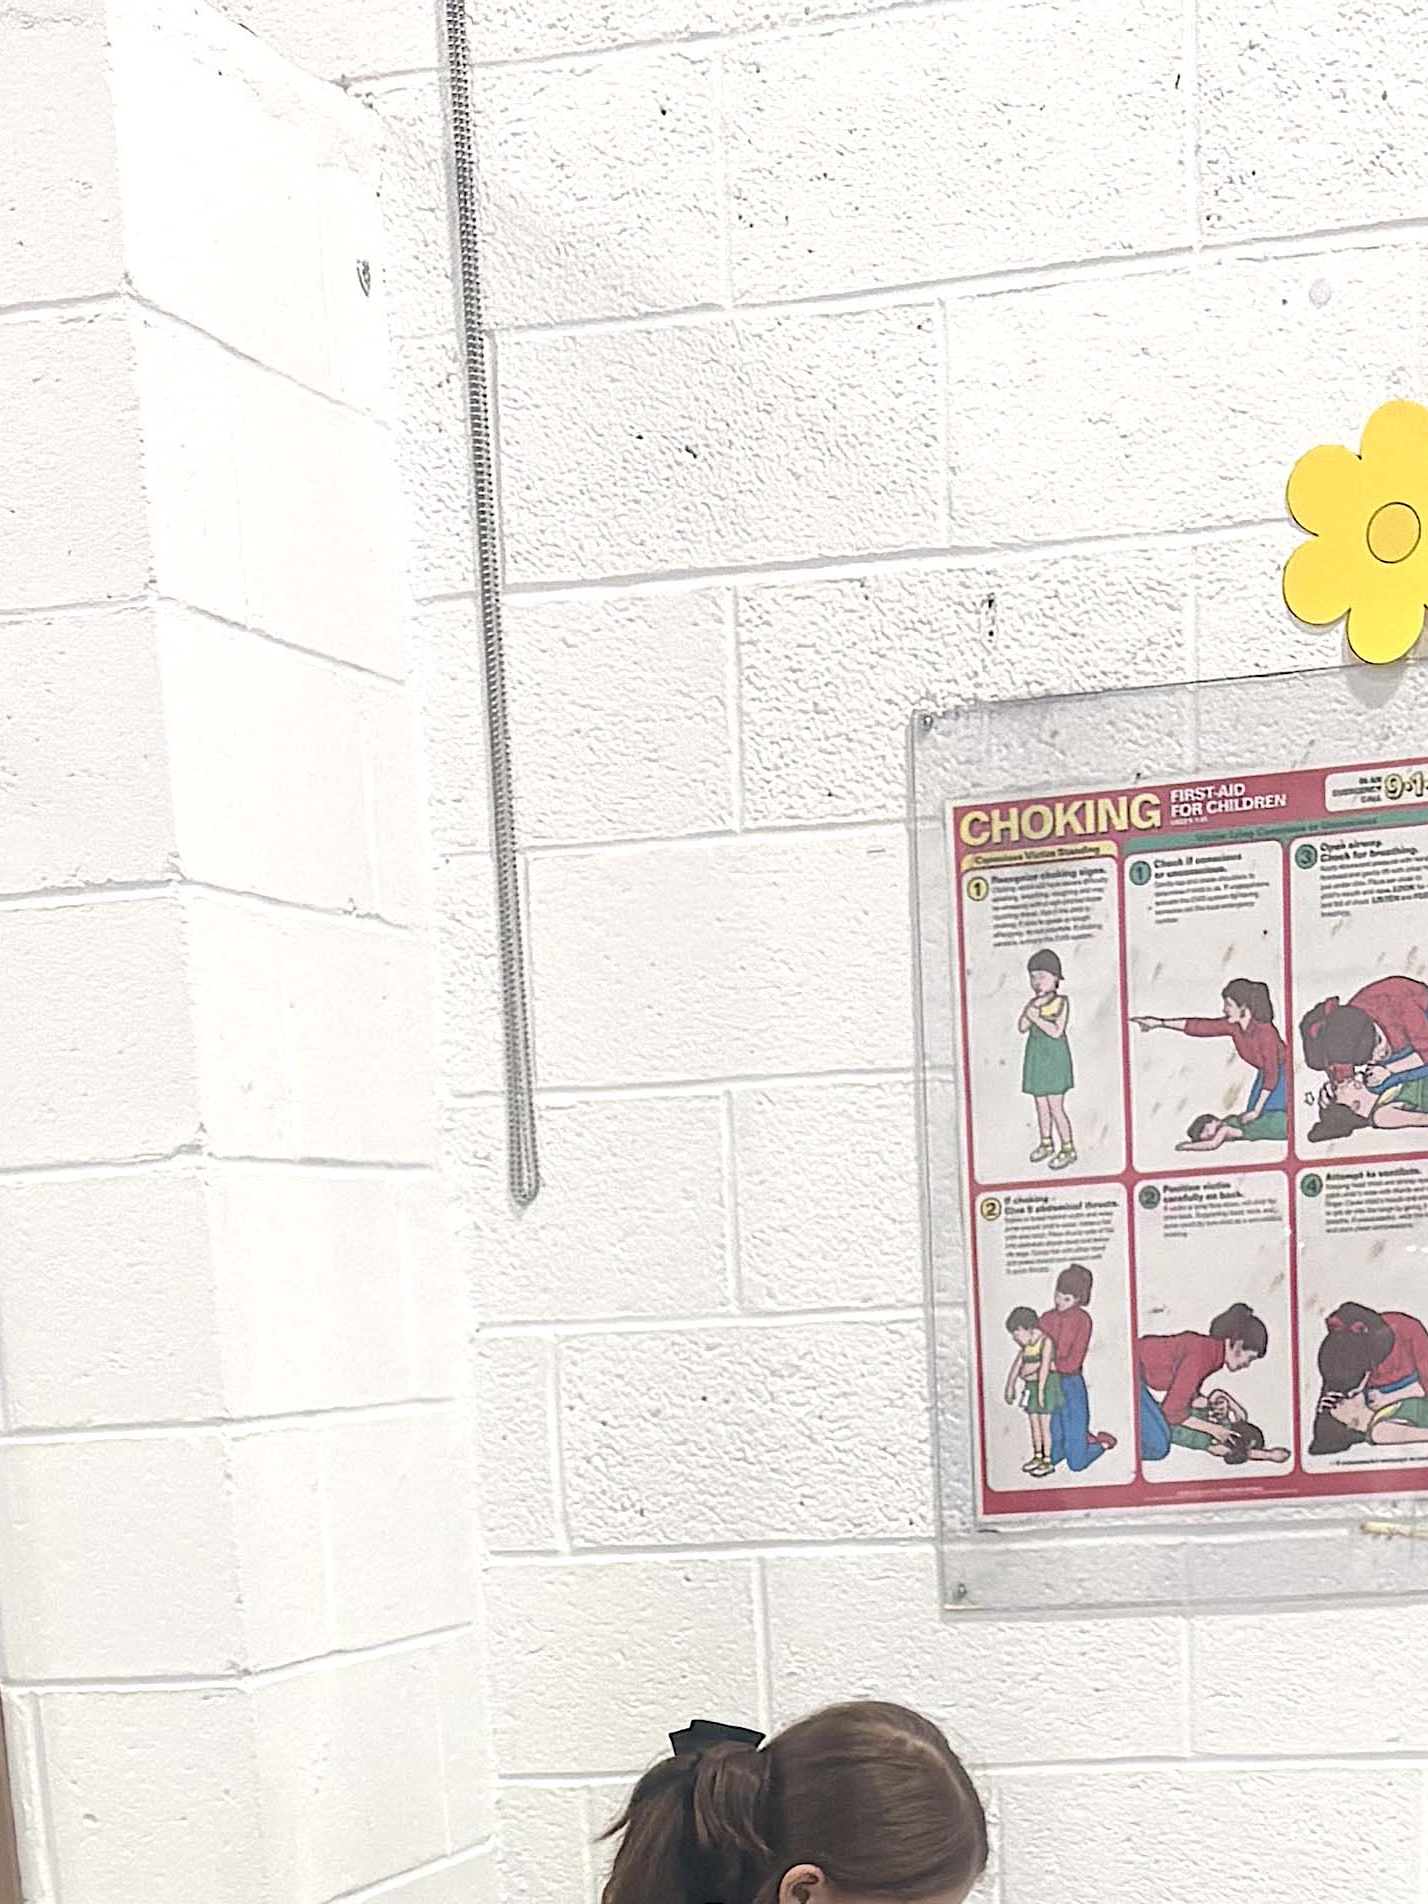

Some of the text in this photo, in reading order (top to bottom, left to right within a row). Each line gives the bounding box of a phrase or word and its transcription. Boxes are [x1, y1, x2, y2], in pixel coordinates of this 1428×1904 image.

[1170, 783, 1246, 803] FIRST-AID
[1170, 794, 1287, 818] FOR CHILDREN
[959, 792, 1162, 848] CHOKING
